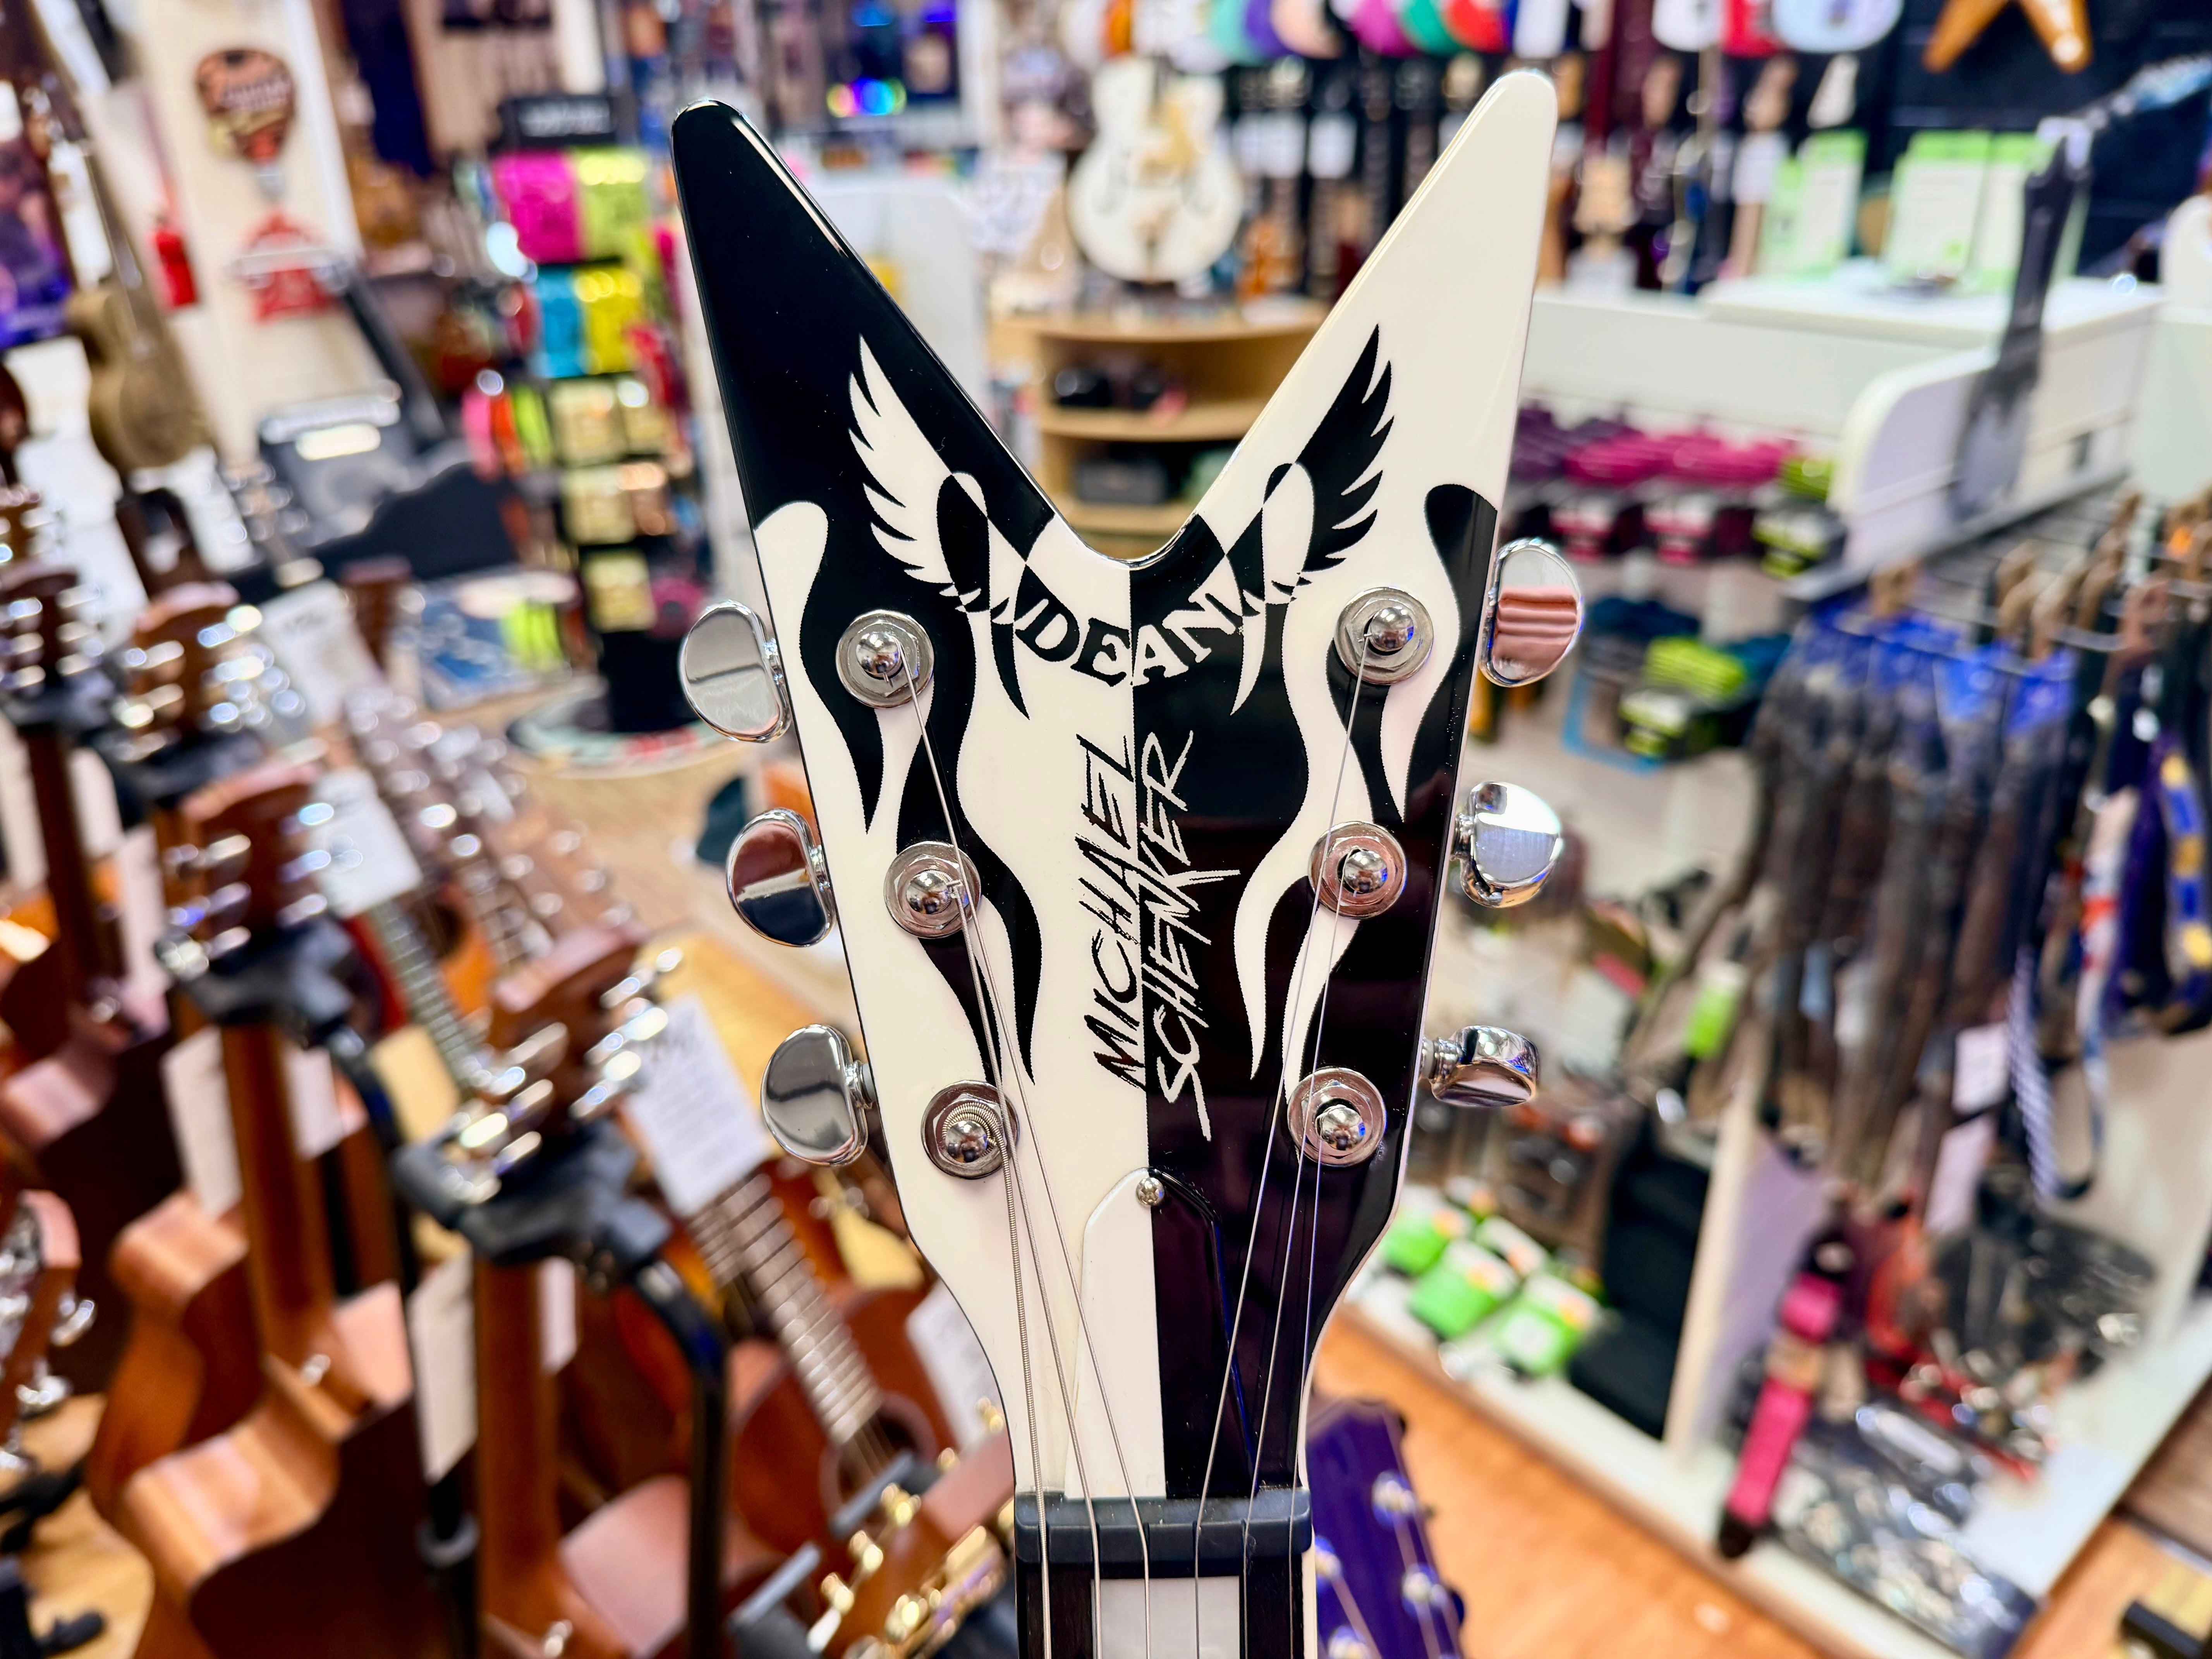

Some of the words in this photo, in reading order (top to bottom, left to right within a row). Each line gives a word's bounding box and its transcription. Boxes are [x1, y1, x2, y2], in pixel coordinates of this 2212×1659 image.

[1015, 592, 1237, 687] DEAN
[1074, 733, 1146, 1092] MICHAEL
[1140, 730, 1241, 1142] SCHENKER
